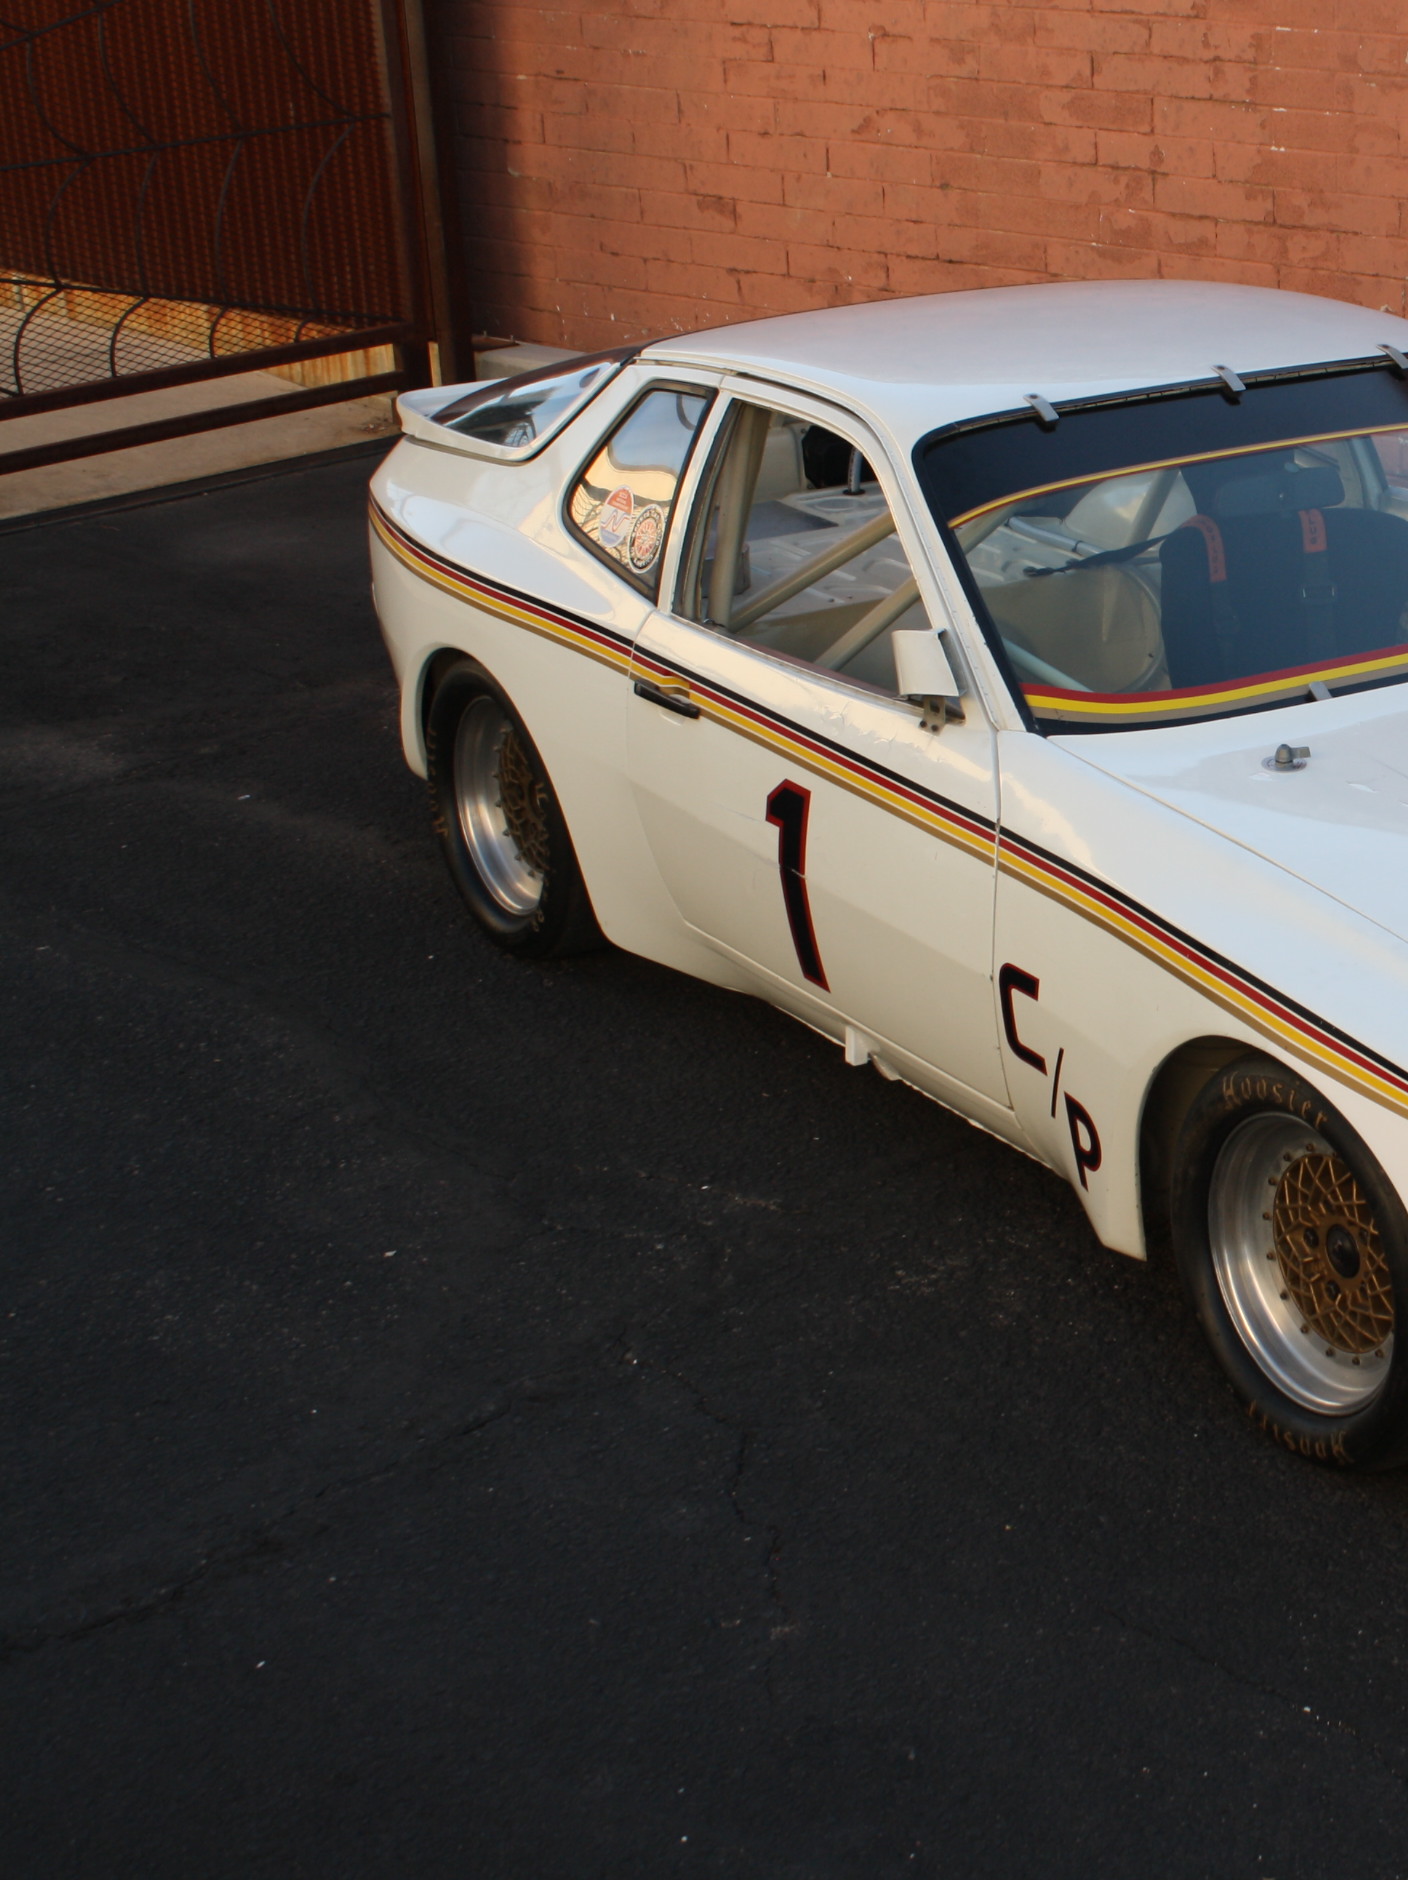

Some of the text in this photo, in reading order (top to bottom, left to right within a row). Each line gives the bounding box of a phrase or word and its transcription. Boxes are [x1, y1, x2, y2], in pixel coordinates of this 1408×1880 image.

[765, 778, 831, 994] 1
[999, 962, 1102, 1193] C/P
[1221, 1071, 1329, 1130] Hoosier
